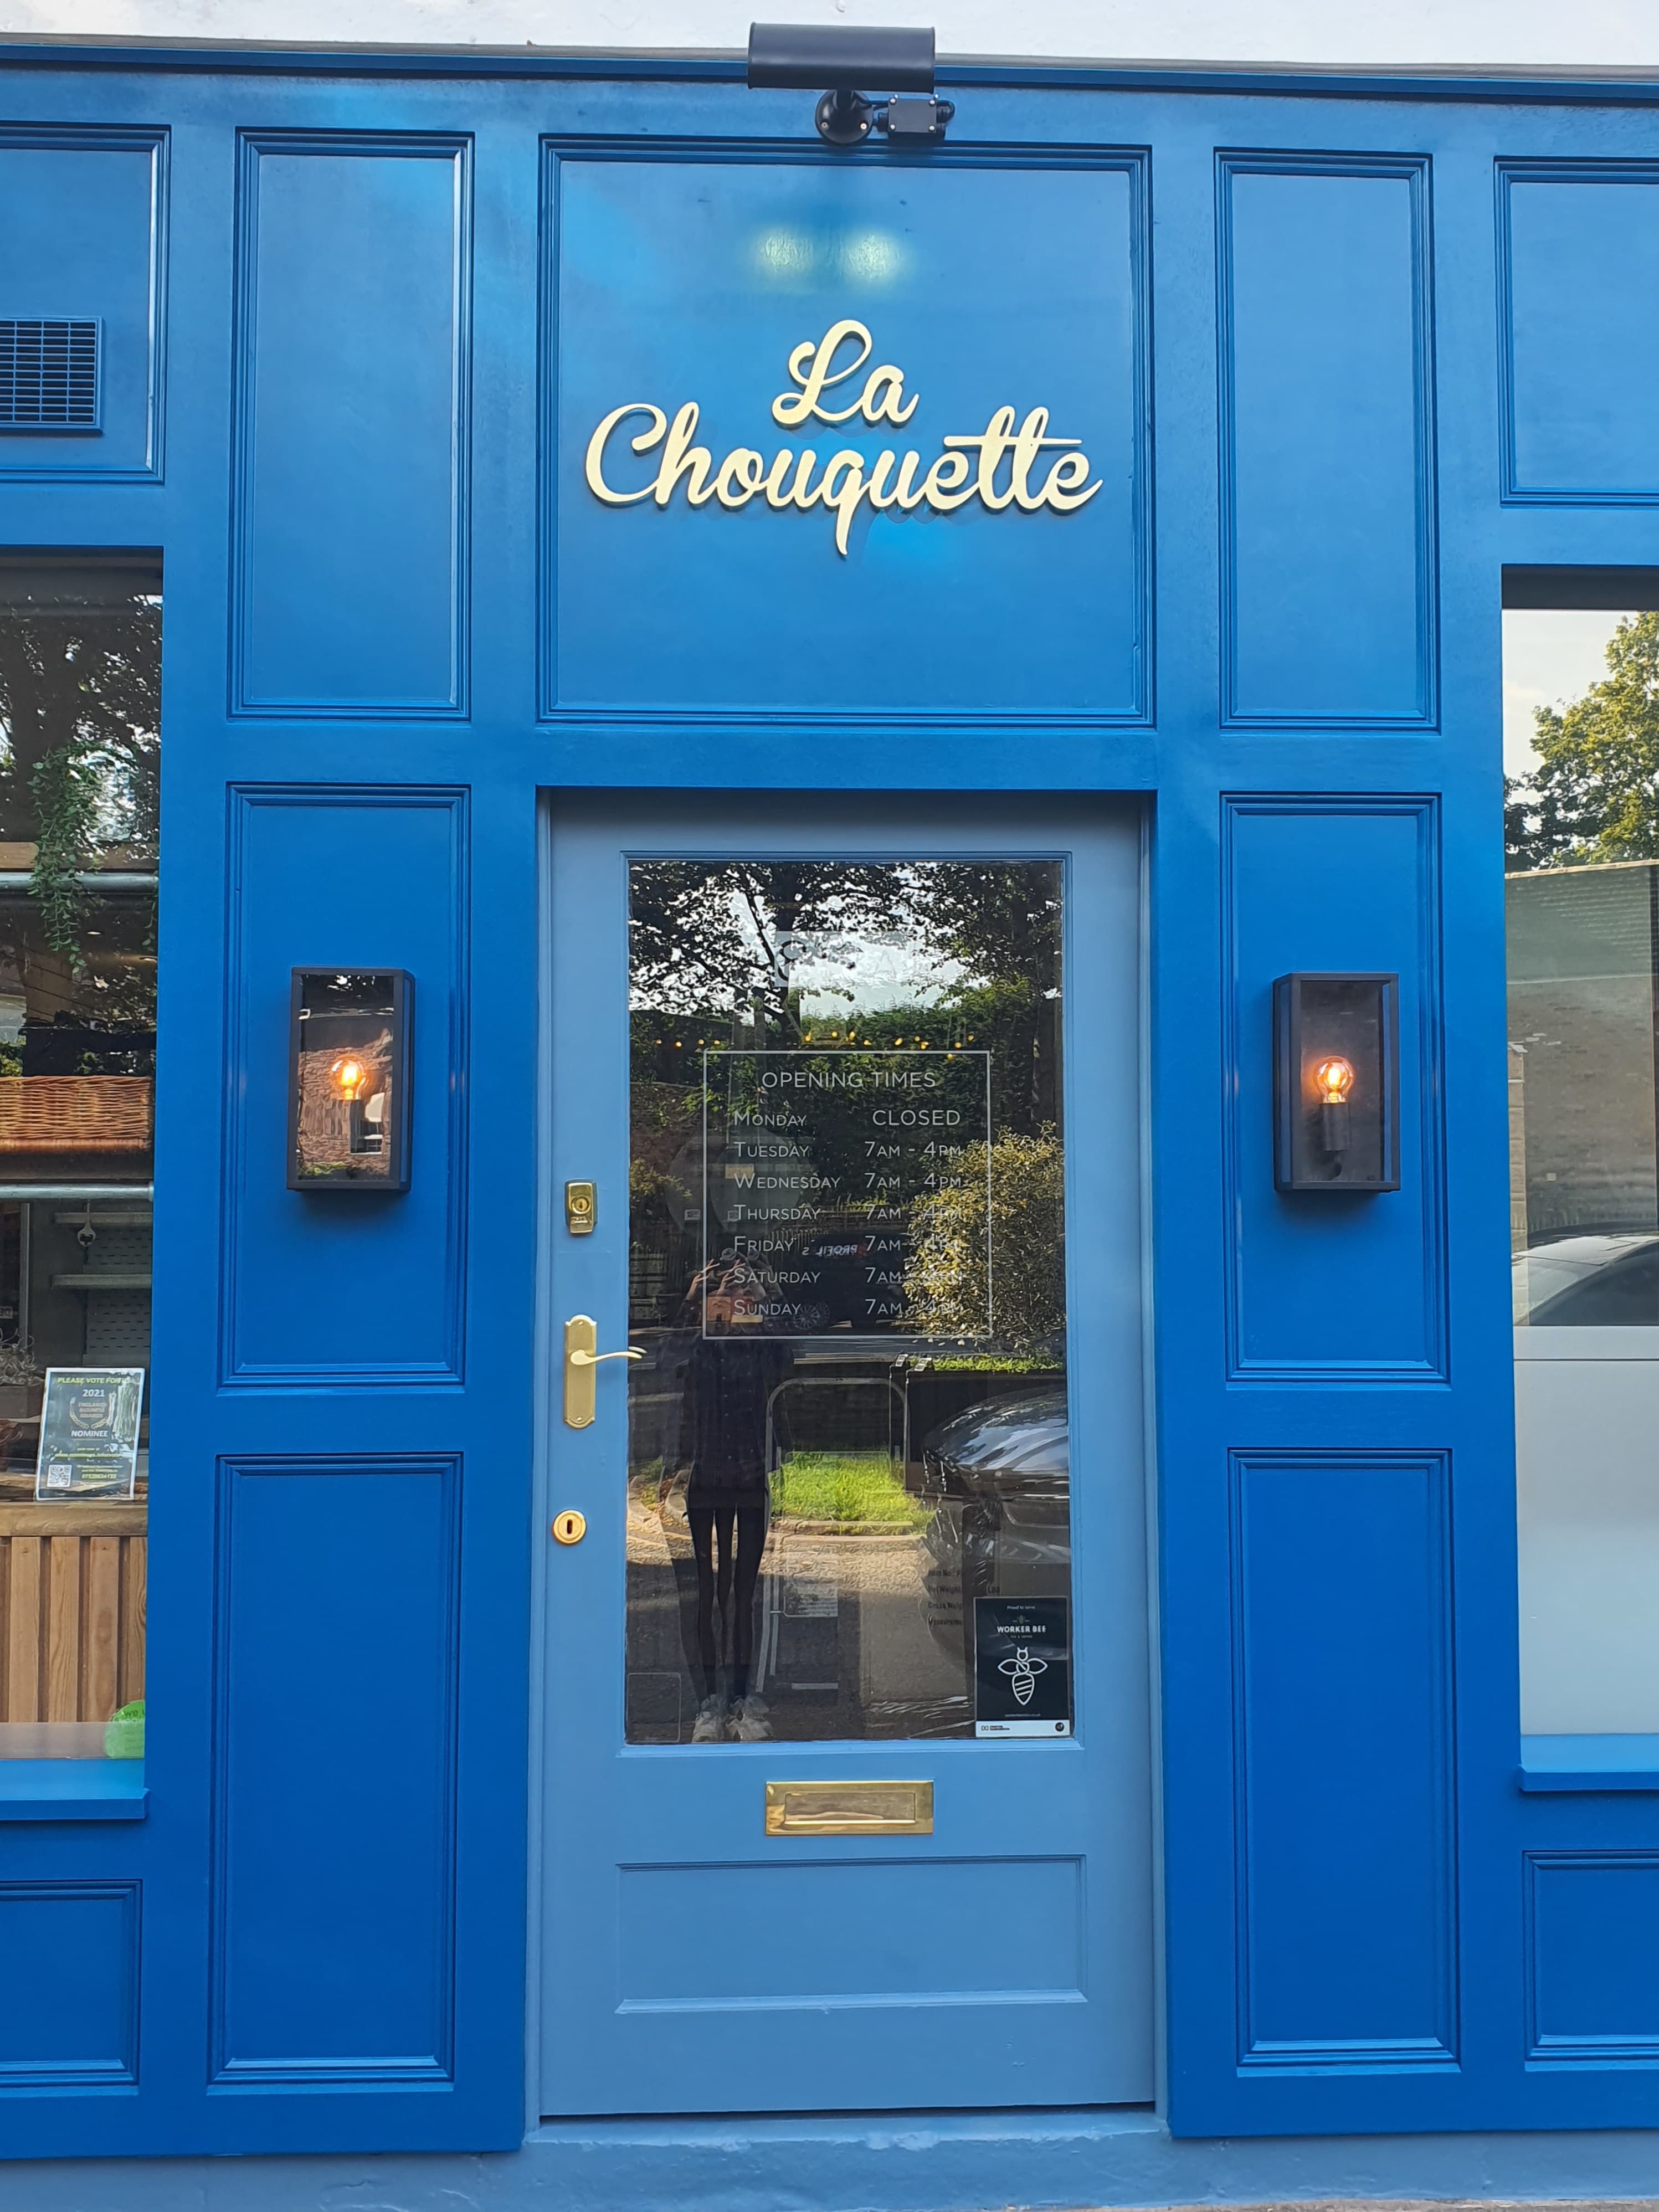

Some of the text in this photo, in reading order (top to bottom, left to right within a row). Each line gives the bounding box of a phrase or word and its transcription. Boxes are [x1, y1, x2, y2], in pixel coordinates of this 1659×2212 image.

[772, 319, 920, 425] La
[585, 401, 1103, 555] Chouquette
[762, 1071, 936, 1089] OPENING TIMES
[872, 1109, 961, 1126] CLOSED
[83, 1389, 105, 1397] 2021
[997, 1625, 1047, 1634] WORKER BEE
